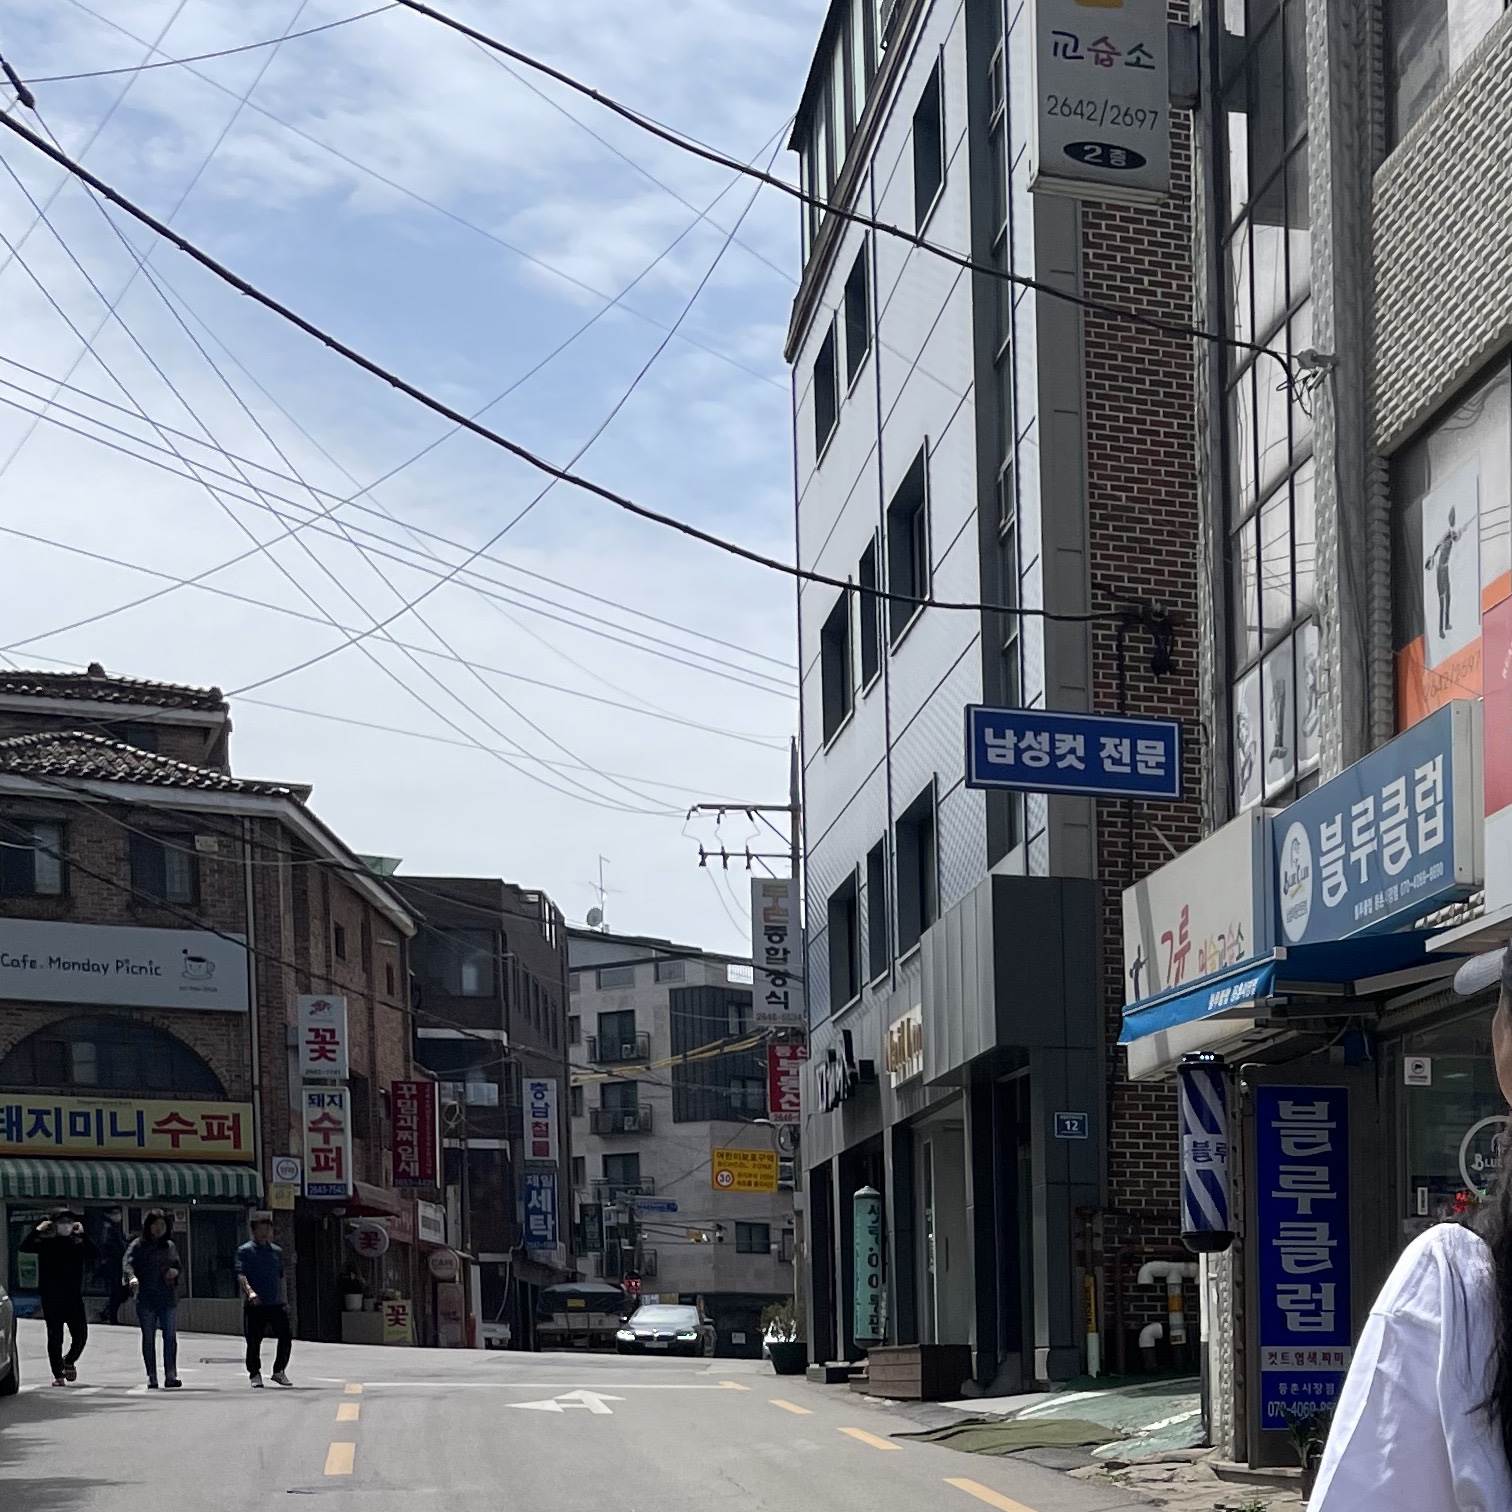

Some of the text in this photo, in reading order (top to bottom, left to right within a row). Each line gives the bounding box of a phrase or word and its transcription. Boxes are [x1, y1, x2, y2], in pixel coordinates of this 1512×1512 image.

[1052, 30, 1156, 70] 교습소
[1047, 94, 1159, 131] 2642/2697
[1083, 144, 1128, 167] 2층
[984, 726, 1168, 777] 남성컷 전문
[1319, 753, 1449, 908] 블루클럽
[48, 956, 110, 975] Monday
[115, 959, 163, 977] Picnic
[305, 1027, 340, 1062] 꽃
[307, 1093, 344, 1109] 돼지
[1065, 1120, 1079, 1131] 12
[308, 1112, 345, 1181] 수퍼
[719, 1173, 731, 1183] 30
[528, 1189, 555, 1240] 세탁
[1271, 1100, 1339, 1333] 블루클럽
[359, 1231, 380, 1251] 꽃
[385, 1305, 409, 1328] 꽃
